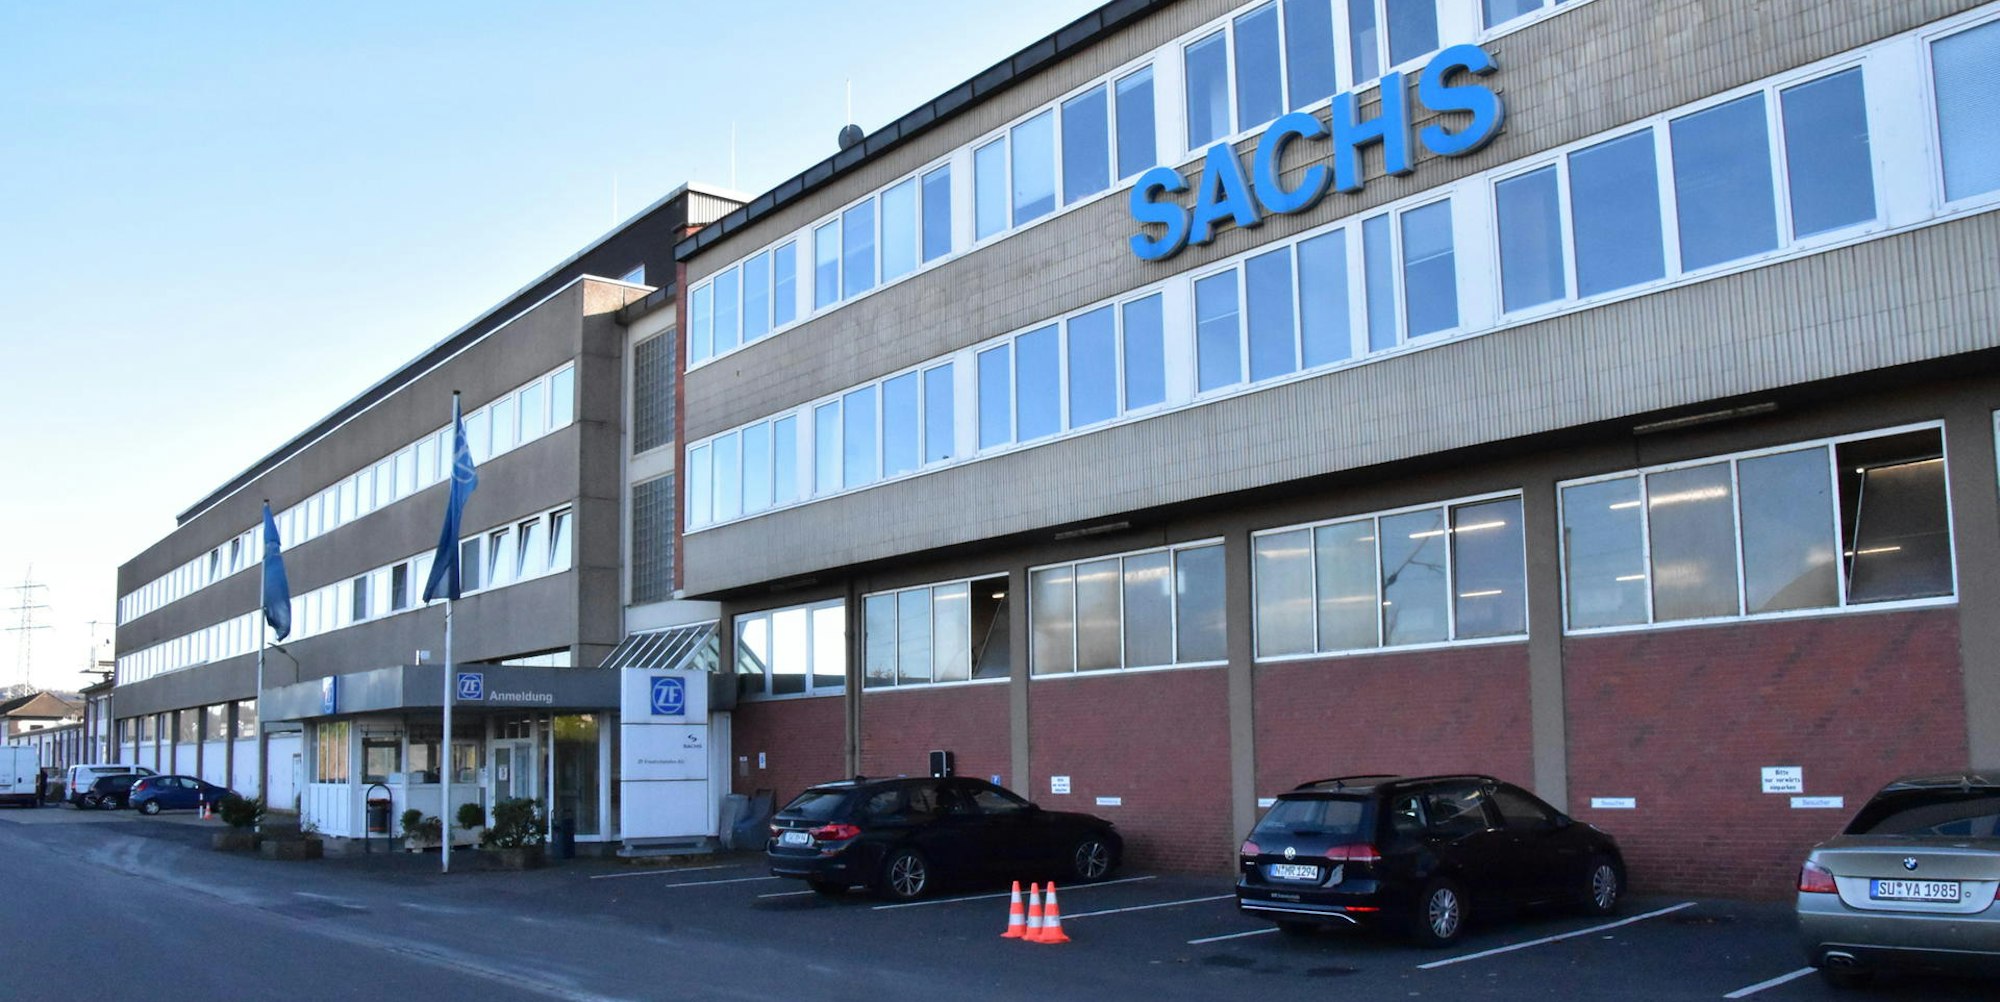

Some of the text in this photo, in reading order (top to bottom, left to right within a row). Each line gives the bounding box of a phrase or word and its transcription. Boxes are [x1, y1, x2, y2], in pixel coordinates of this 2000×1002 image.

[1129, 43, 1505, 261] SACHS
[489, 691, 553, 704] Anmeldung
[655, 685, 682, 707] ZF
[1879, 881, 1957, 898] SU YA 1985
